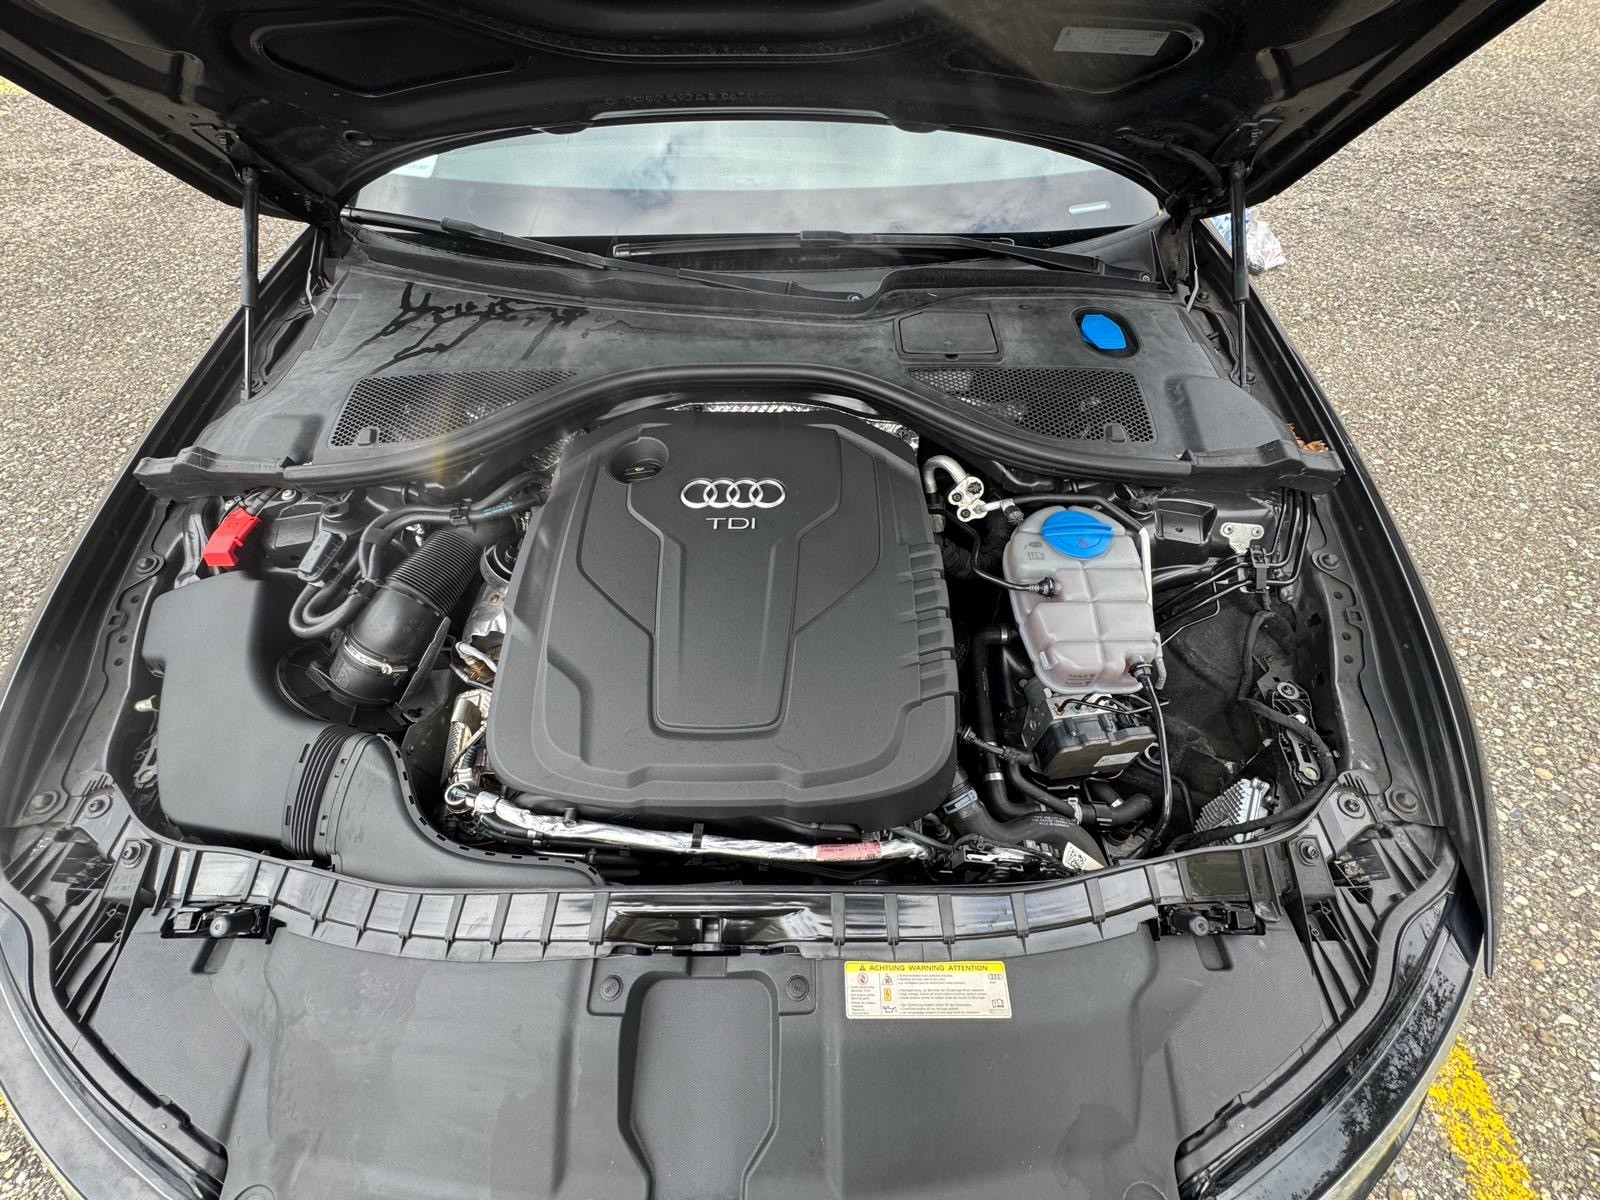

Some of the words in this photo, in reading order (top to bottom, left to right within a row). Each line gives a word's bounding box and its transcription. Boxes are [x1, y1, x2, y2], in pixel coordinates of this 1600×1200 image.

[705, 517, 756, 530] TDI
[869, 964, 905, 972] ACHTUNG
[908, 964, 945, 972] WARNING
[948, 964, 988, 972] ATTENTION
